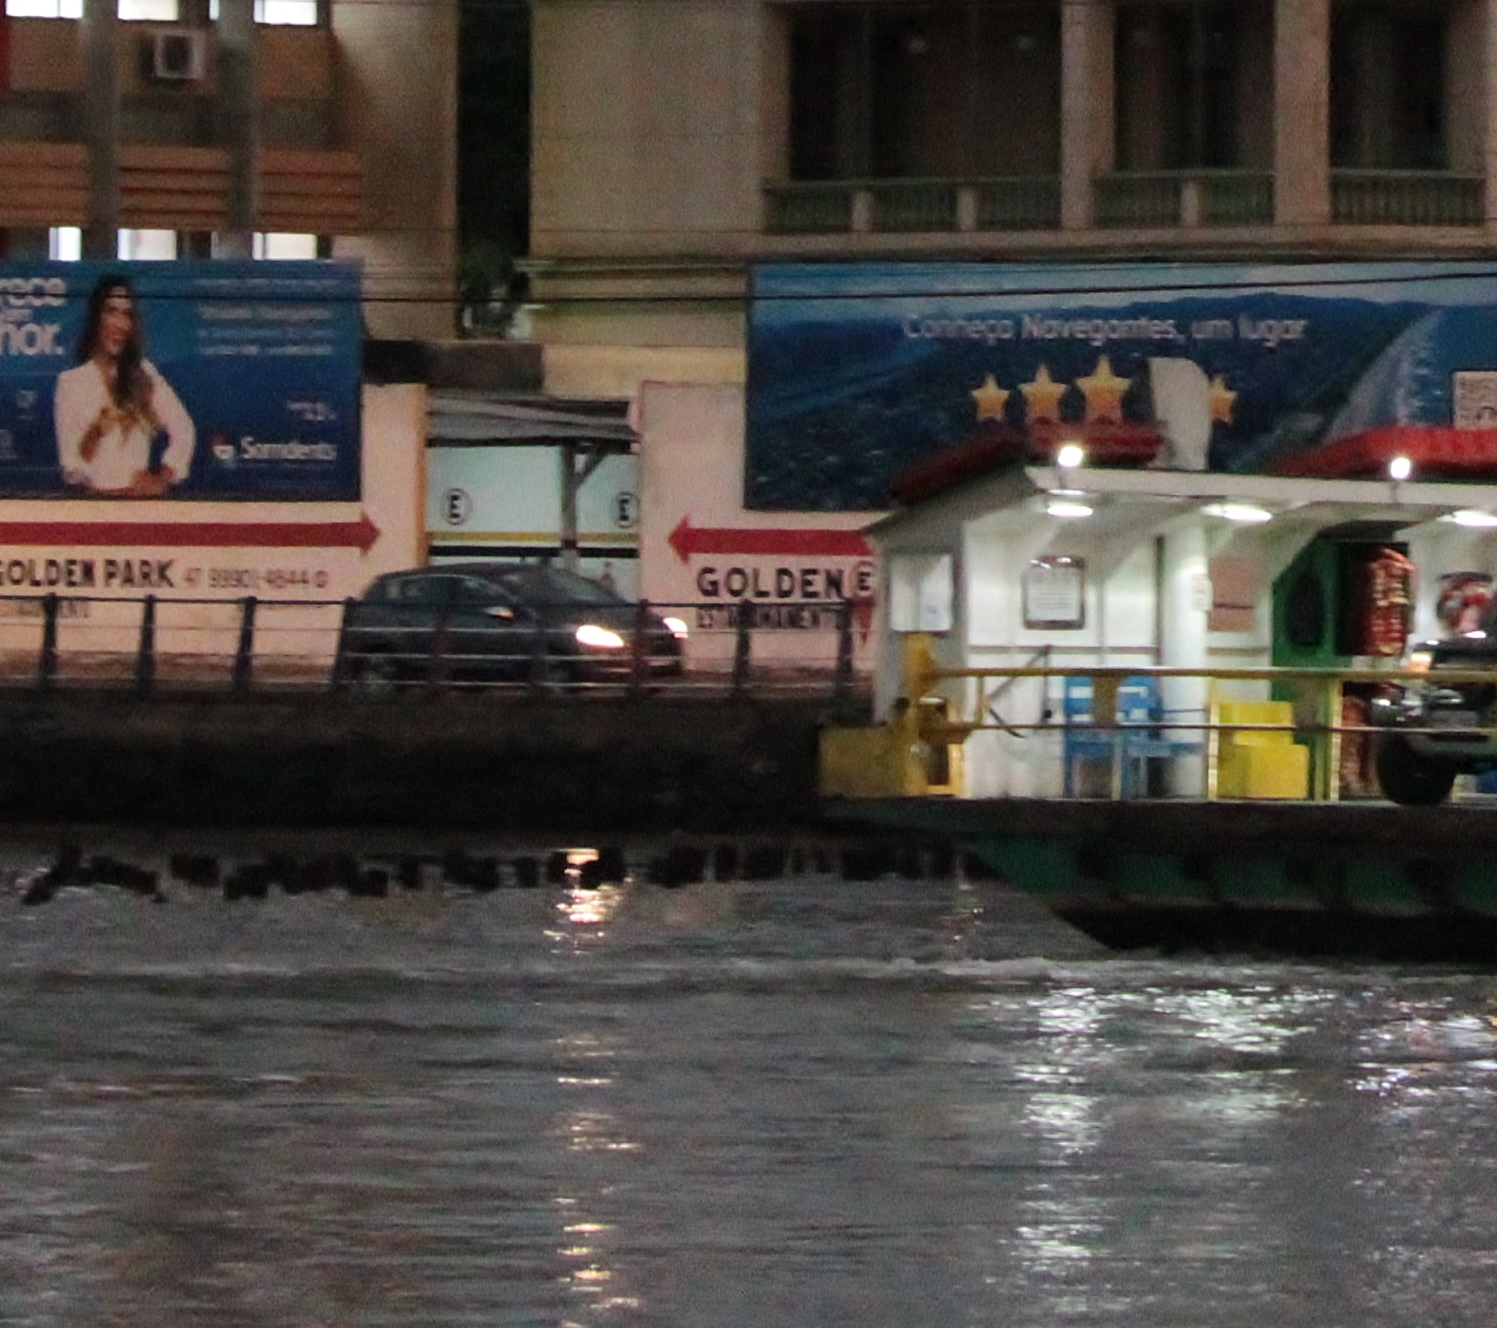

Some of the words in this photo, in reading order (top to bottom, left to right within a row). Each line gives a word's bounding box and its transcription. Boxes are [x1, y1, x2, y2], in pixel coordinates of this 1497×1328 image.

[1189, 319, 1233, 339] um
[1239, 312, 1310, 347] lugar
[104, 559, 175, 589] PARK
[697, 565, 844, 599] GOLDEN
